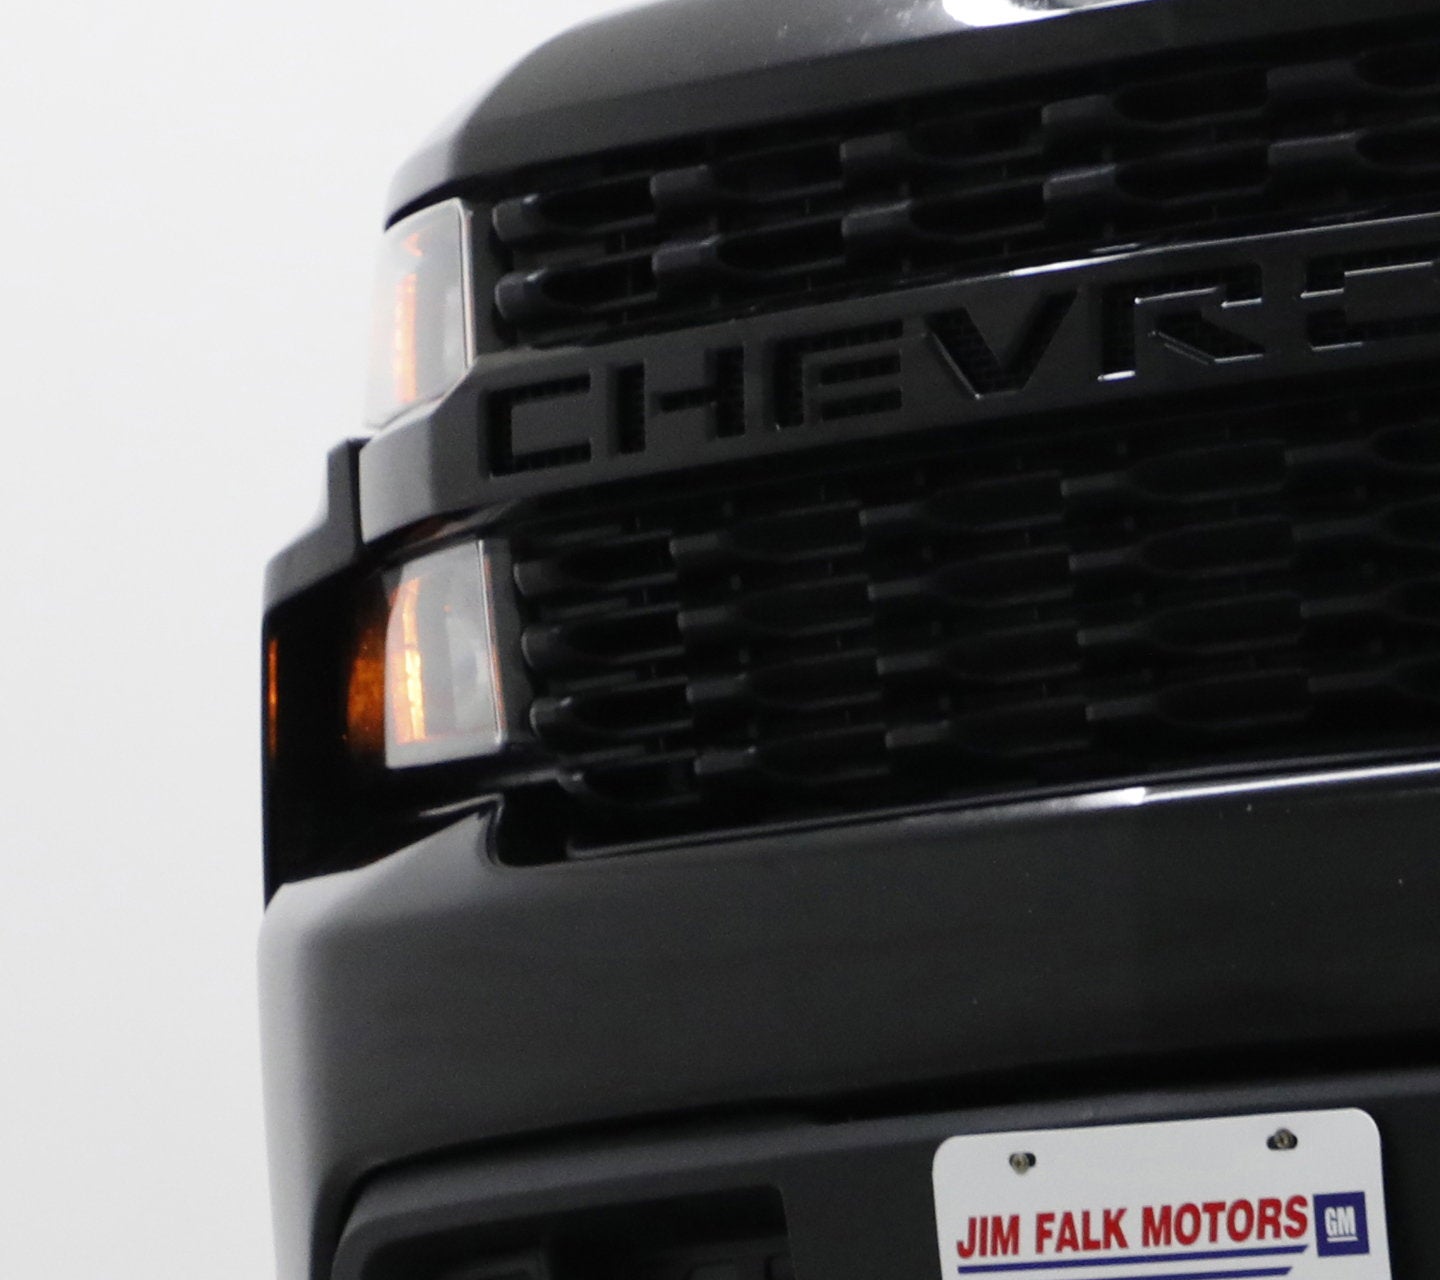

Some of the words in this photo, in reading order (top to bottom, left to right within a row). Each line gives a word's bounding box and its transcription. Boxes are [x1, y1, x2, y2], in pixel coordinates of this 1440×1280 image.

[957, 1215, 1020, 1259] JIM
[1035, 1208, 1128, 1254] FALK
[1142, 1195, 1308, 1248] MOTORS
[1324, 1206, 1357, 1237] GM
